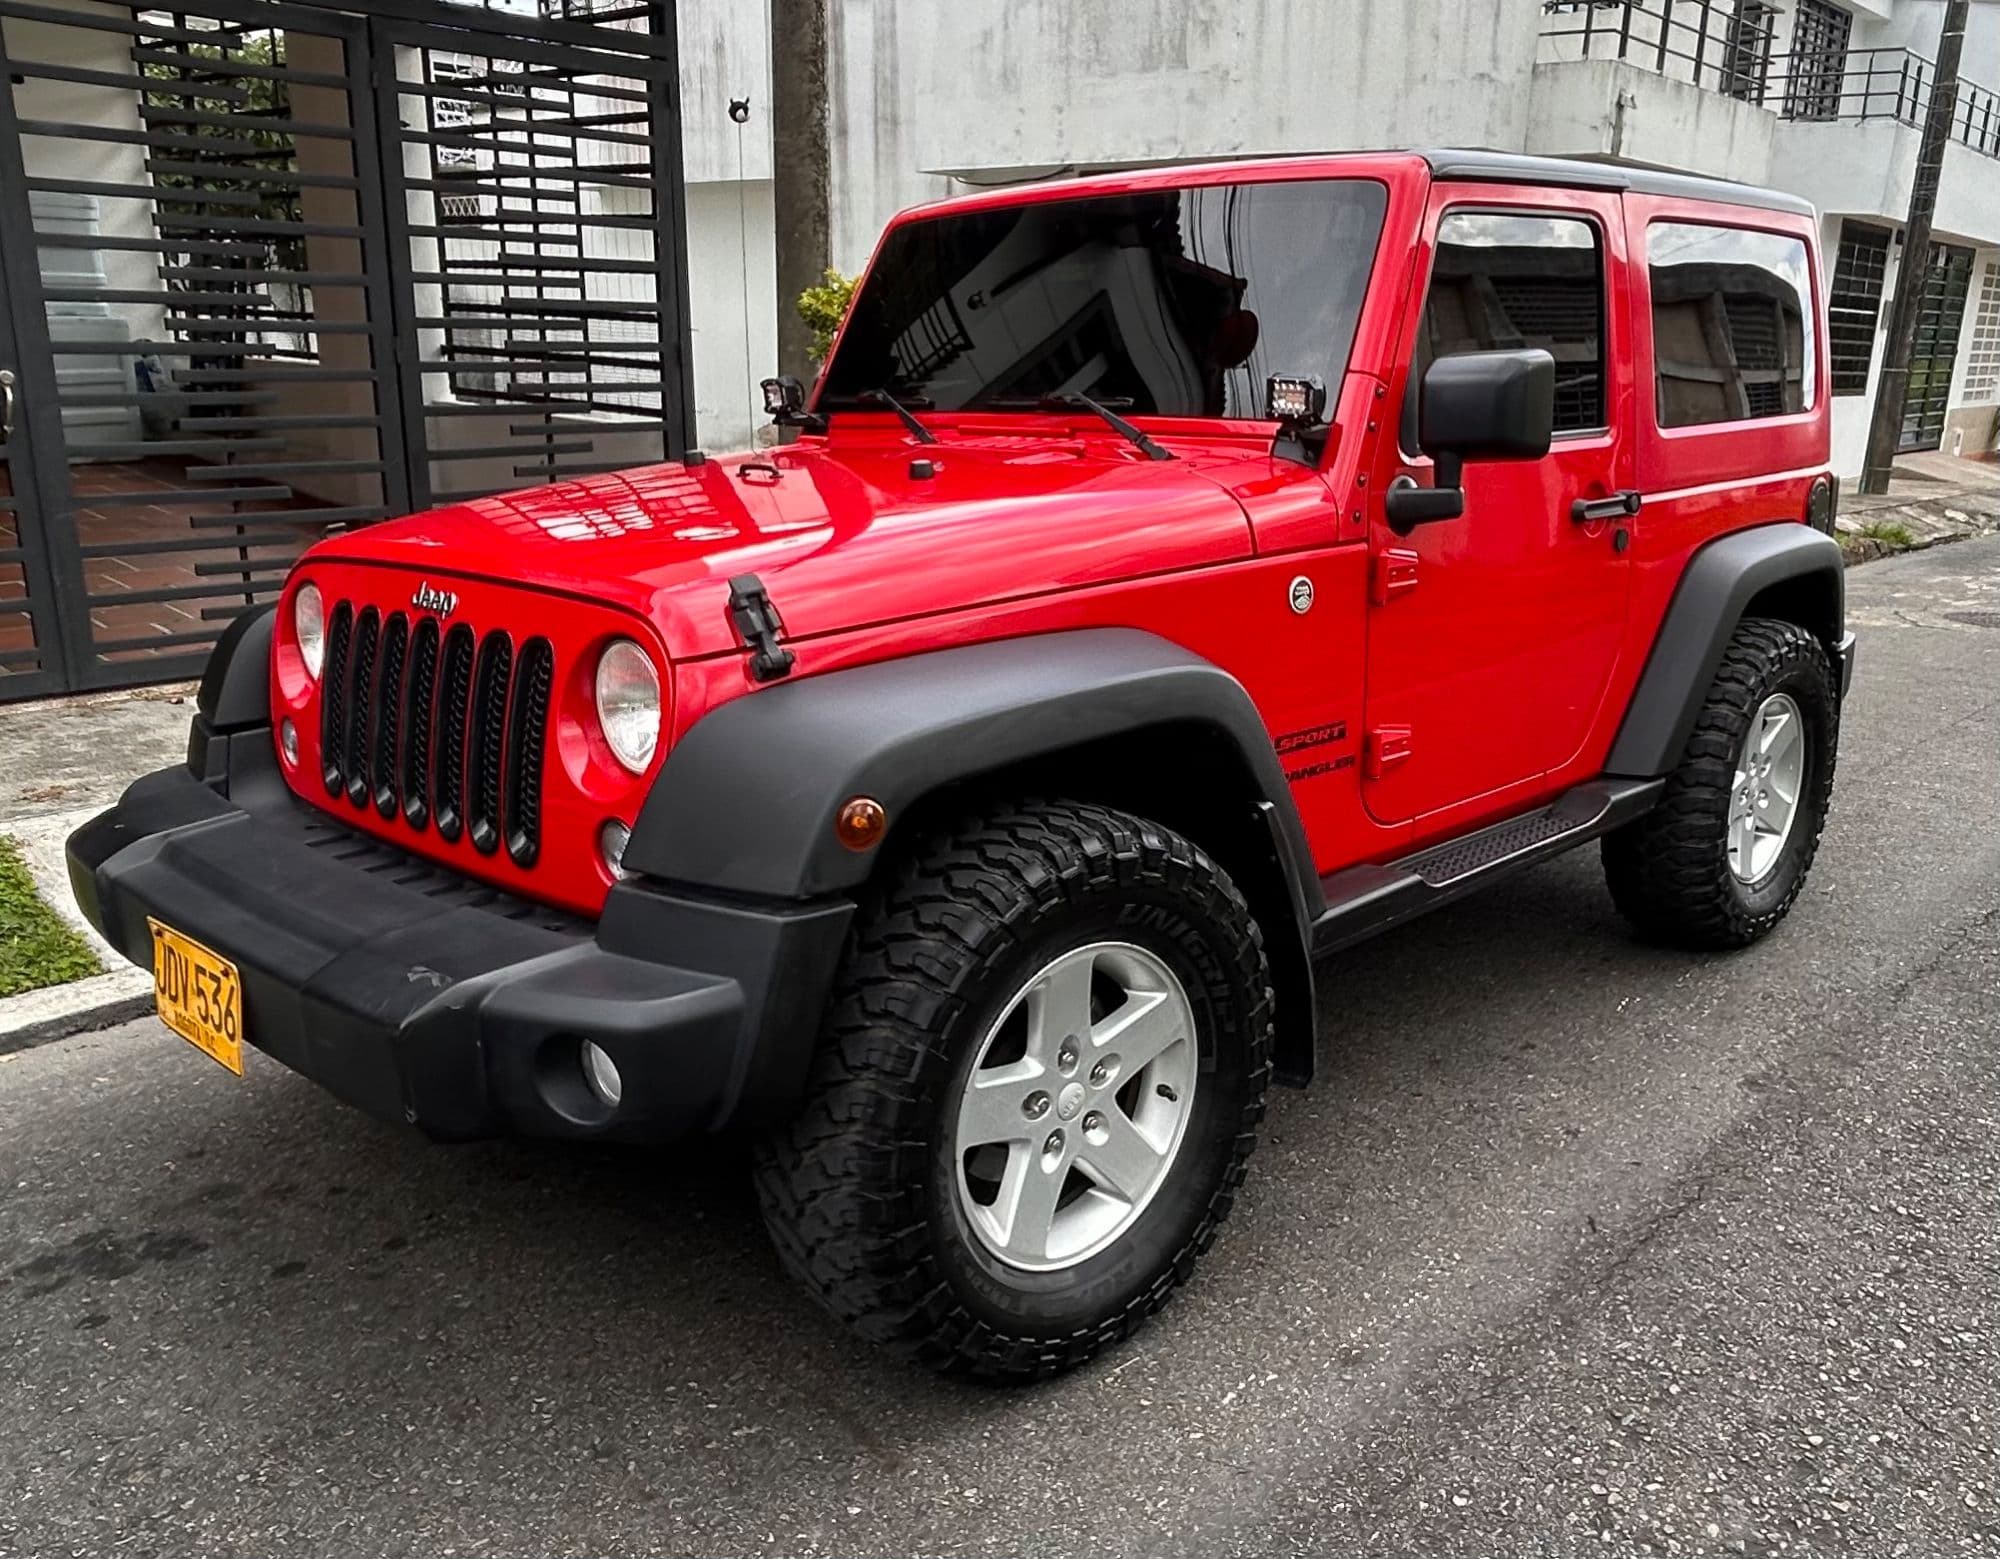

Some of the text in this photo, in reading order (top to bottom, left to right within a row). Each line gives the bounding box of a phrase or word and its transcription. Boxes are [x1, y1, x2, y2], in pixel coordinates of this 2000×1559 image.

[411, 580, 459, 620] Jeep
[1280, 725, 1346, 749] SPORT
[195, 963, 236, 1043] 536
